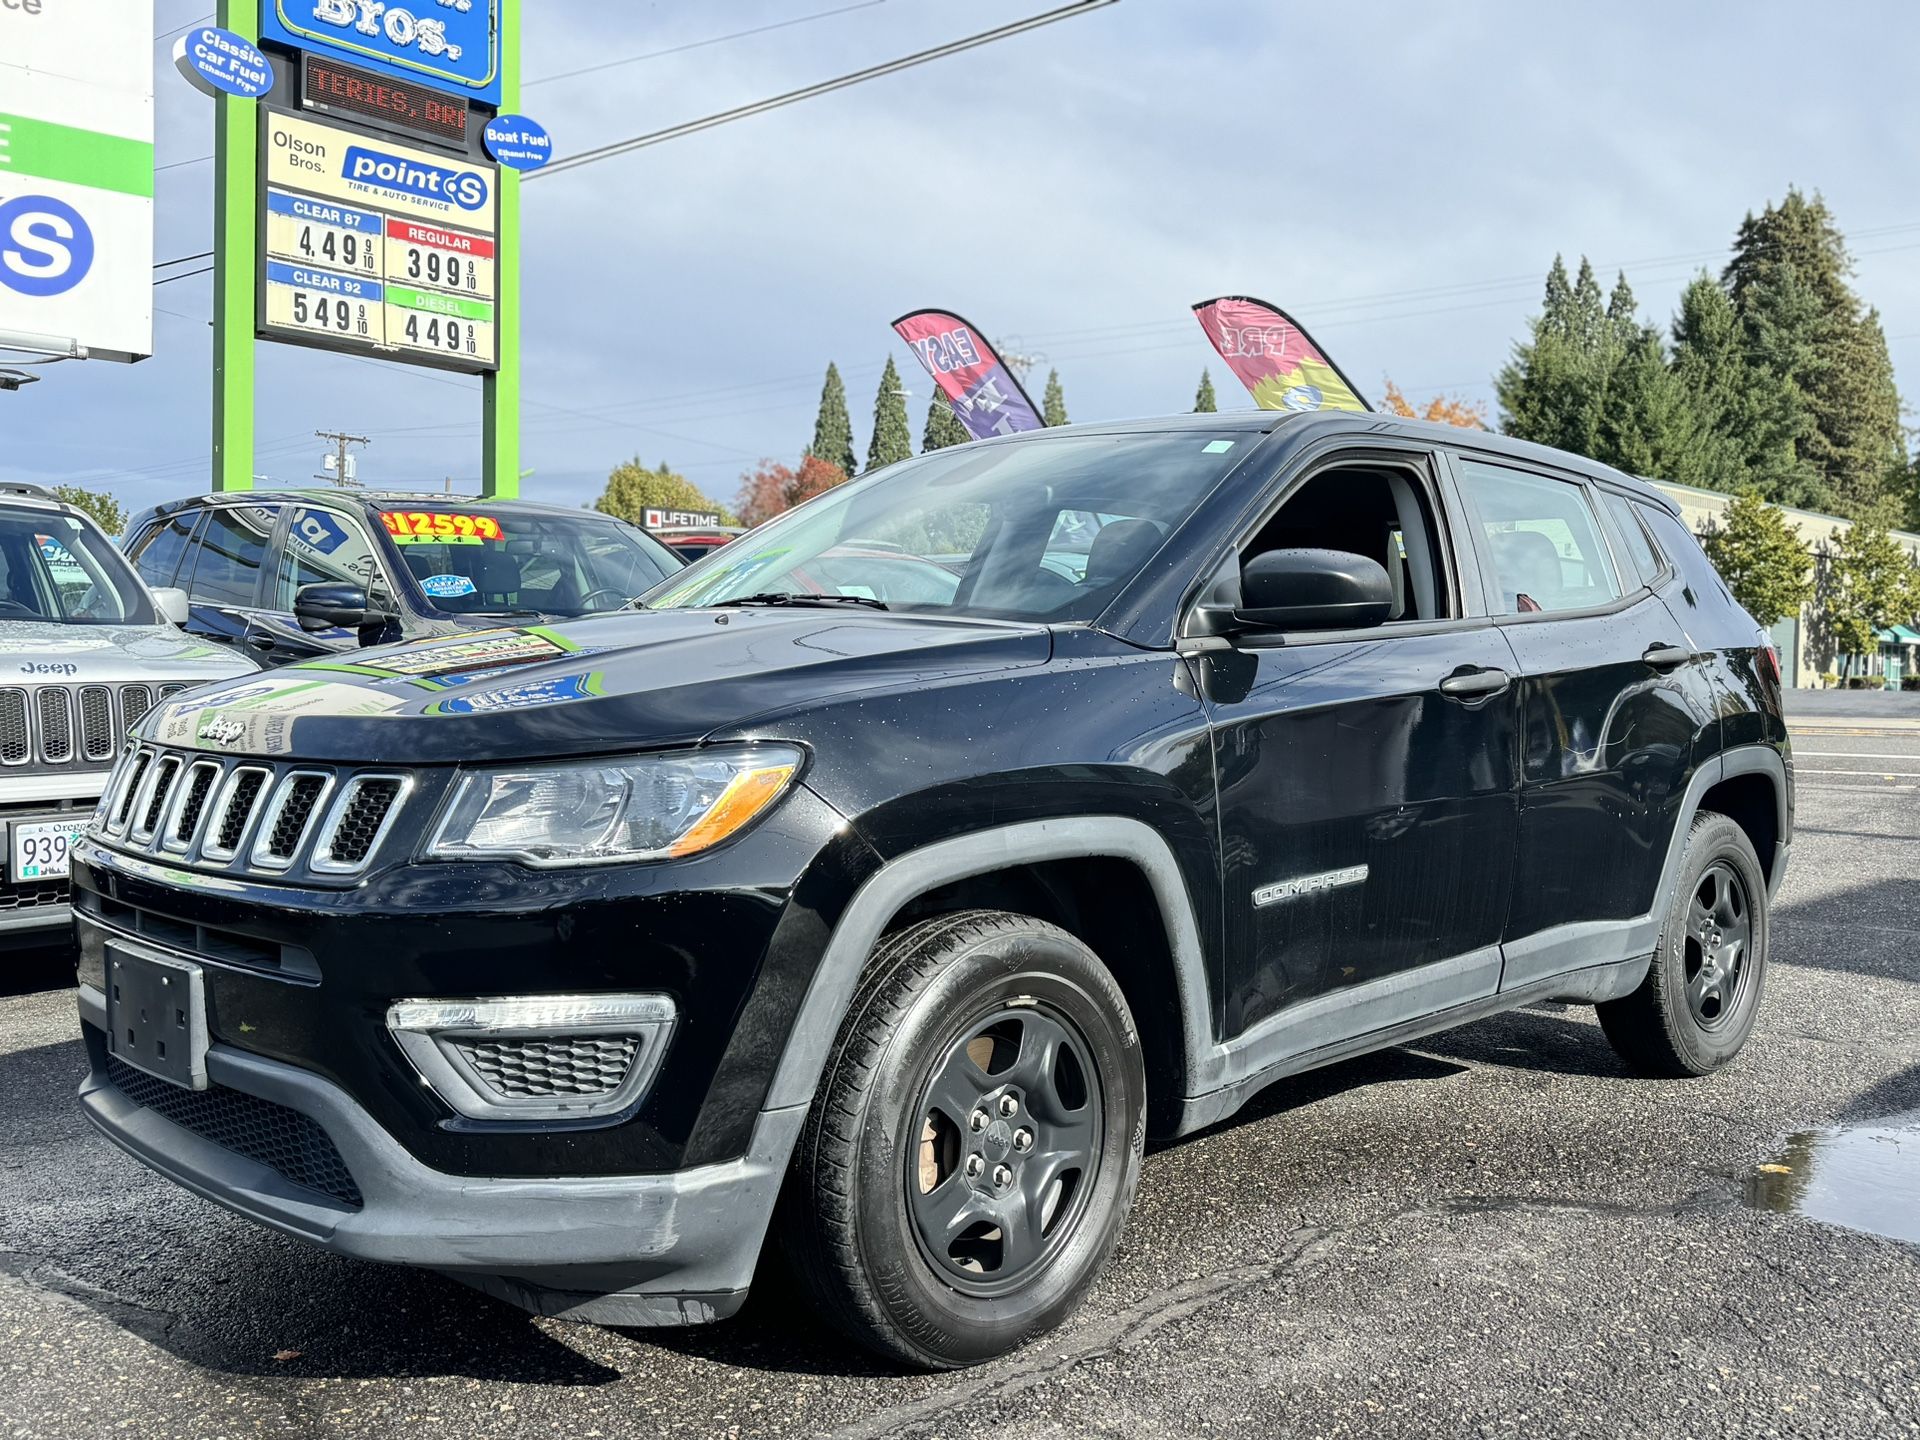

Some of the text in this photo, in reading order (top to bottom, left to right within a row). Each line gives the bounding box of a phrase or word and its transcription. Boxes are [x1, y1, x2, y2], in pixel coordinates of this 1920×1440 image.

[201, 30, 264, 68] Classic
[194, 43, 266, 85] Car Fuel
[198, 61, 234, 82] Ethanol
[273, 131, 326, 157] Olson
[487, 128, 549, 147] Boat Fuel
[289, 153, 325, 173] Bros.
[497, 148, 543, 160] Ethanol Free
[353, 155, 439, 191] point
[348, 181, 450, 211] TIRE & AUTO SERVICE
[293, 201, 361, 228] CLEAR 87
[408, 227, 471, 251] REGULAR
[407, 248, 460, 286] 399
[293, 270, 361, 295] CLEAR 92
[294, 292, 349, 331] 549
[416, 295, 462, 314] DIESEL
[405, 315, 459, 350] 449
[381, 512, 498, 538] $12599
[661, 511, 718, 528] LIFETIME
[20, 662, 78, 676] Jeep
[198, 714, 246, 746] Jeep
[23, 835, 67, 865] 939
[1252, 864, 1369, 908] COMPASS
